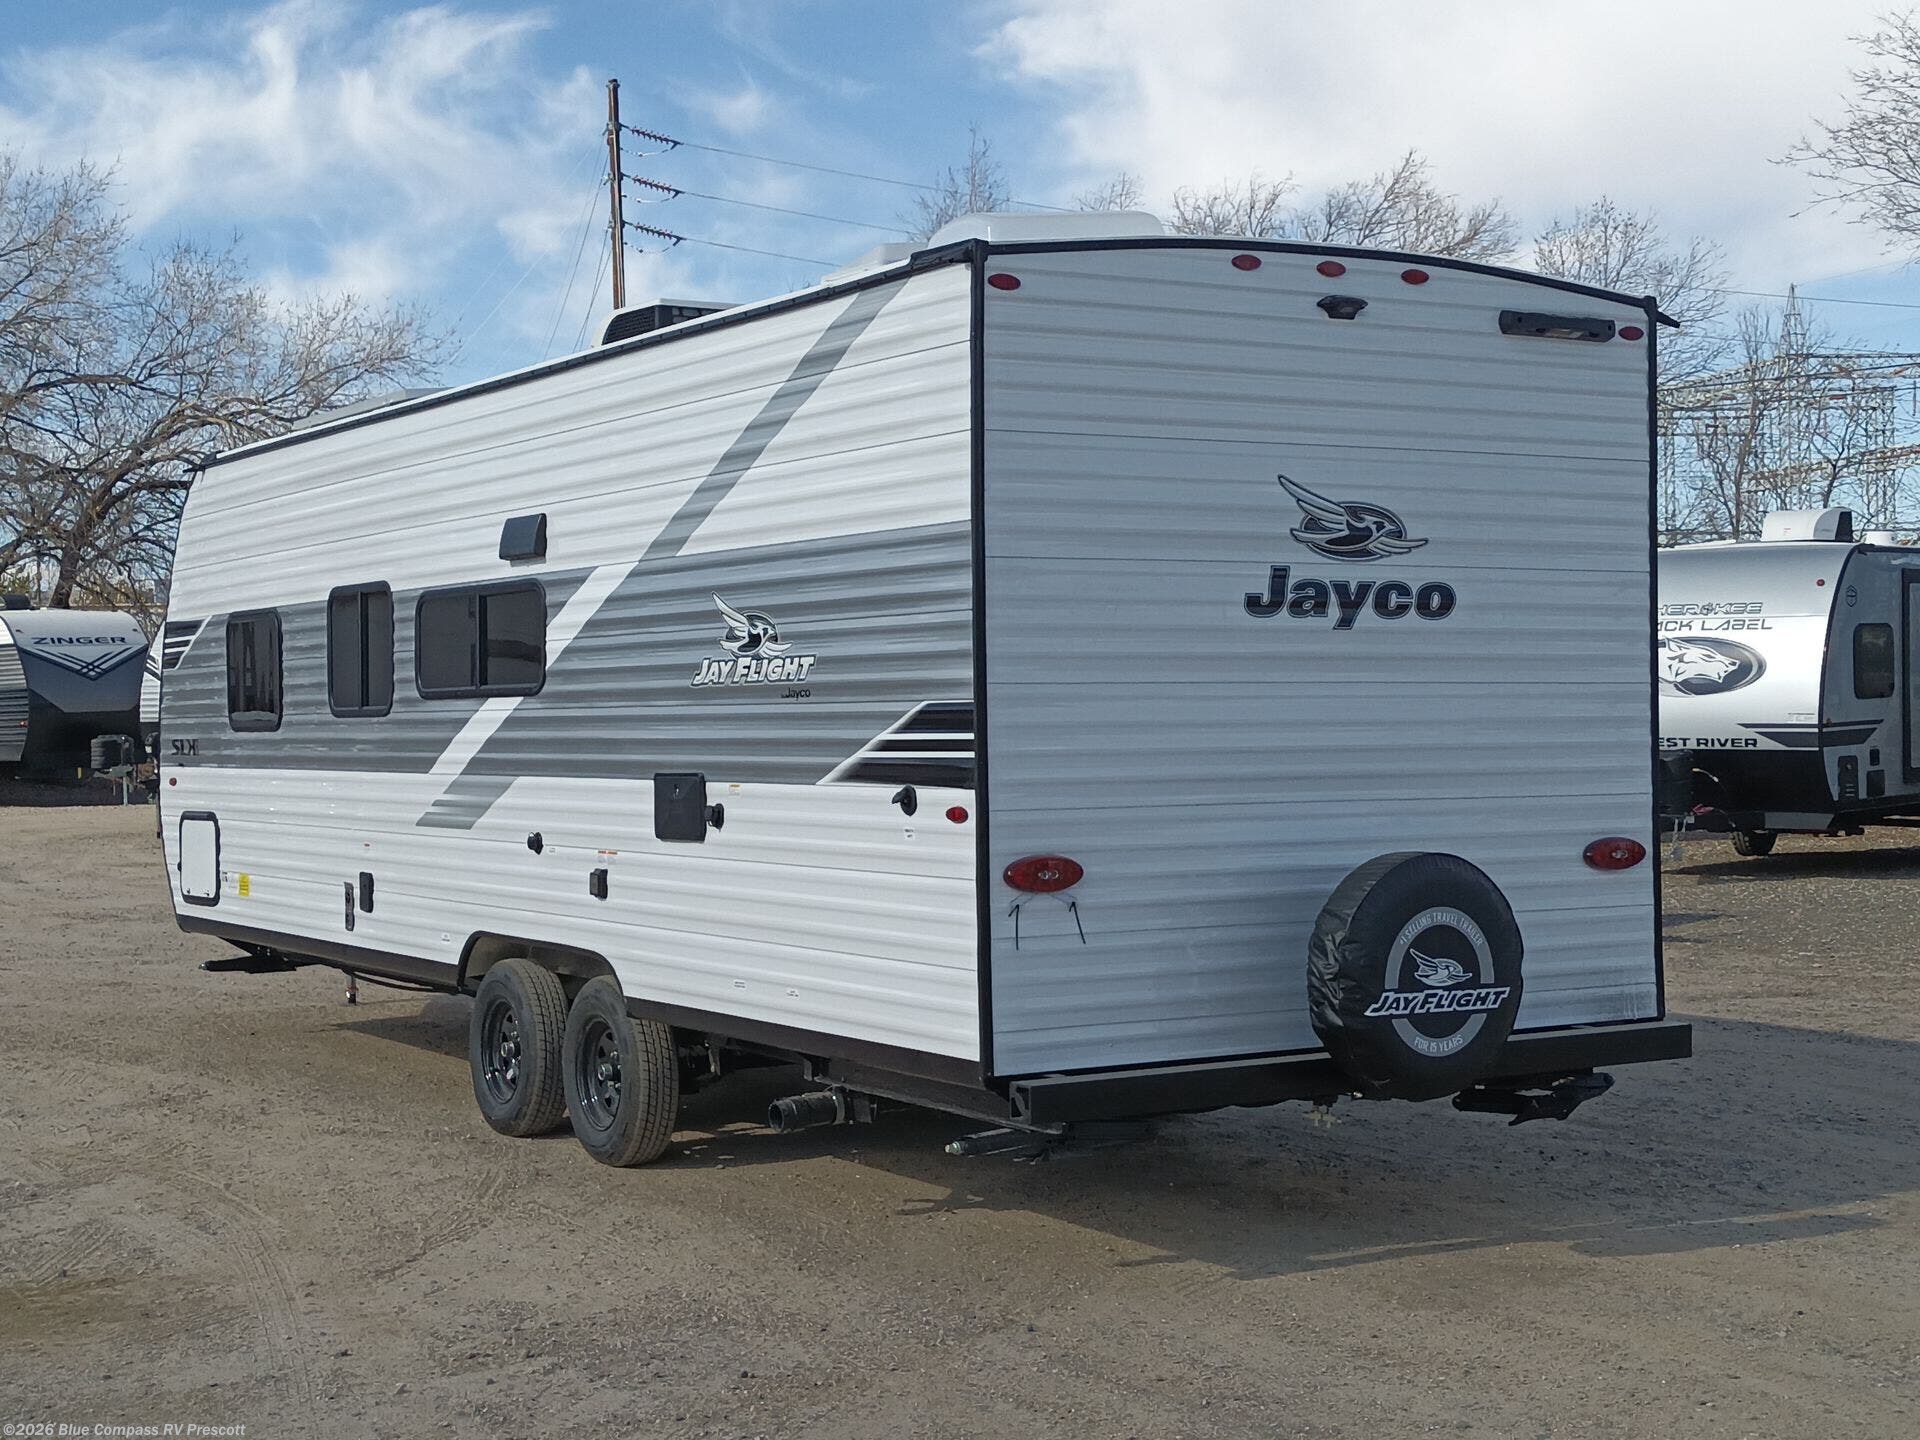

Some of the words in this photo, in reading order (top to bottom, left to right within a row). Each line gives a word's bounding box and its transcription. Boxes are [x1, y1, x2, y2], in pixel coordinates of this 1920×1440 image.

[1244, 565, 1457, 630] Jayco
[1658, 603, 1763, 616] HEROKEE
[1701, 618, 1774, 631] LABEL
[31, 636, 127, 645] ZINGER
[785, 687, 811, 701] Jayco
[1658, 737, 1691, 748] EST
[1695, 737, 1758, 748] RIVER
[1405, 913, 1432, 939] SELLING
[1433, 912, 1458, 926] TRAVEL
[1459, 917, 1484, 946] TRAILER
[1414, 1037, 1429, 1052] FOR
[1439, 1034, 1463, 1052] YEARS
